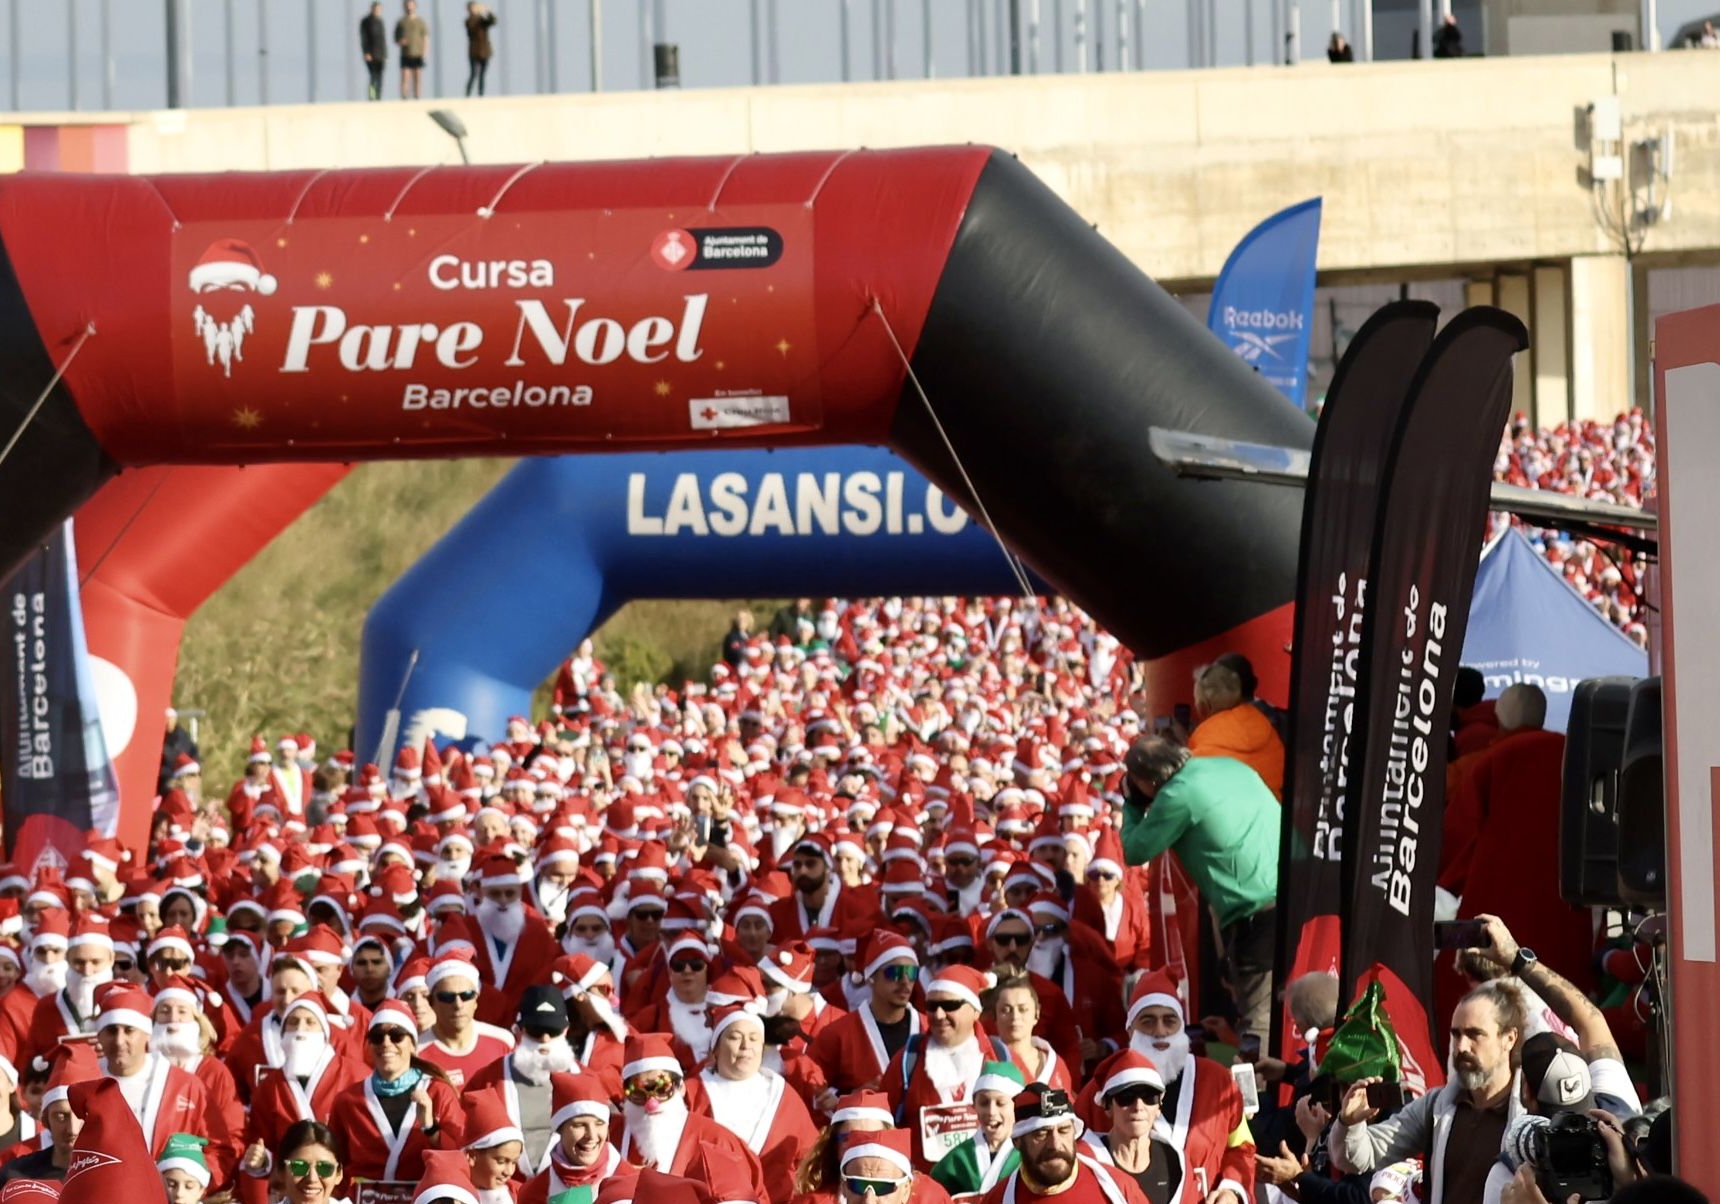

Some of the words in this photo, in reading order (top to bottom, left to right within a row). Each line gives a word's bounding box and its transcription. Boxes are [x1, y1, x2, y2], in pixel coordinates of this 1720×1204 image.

[703, 245, 768, 259] Barcelona
[704, 235, 756, 247] Ajuntament
[756, 234, 768, 244] de
[429, 255, 555, 290] Cursa
[279, 305, 484, 373] Pare
[504, 293, 709, 368] Noel
[402, 381, 594, 411] Barcelona
[1522, 658, 1540, 669] by
[31, 592, 54, 779] Barcelona
[1389, 601, 1448, 917] Barcelona
